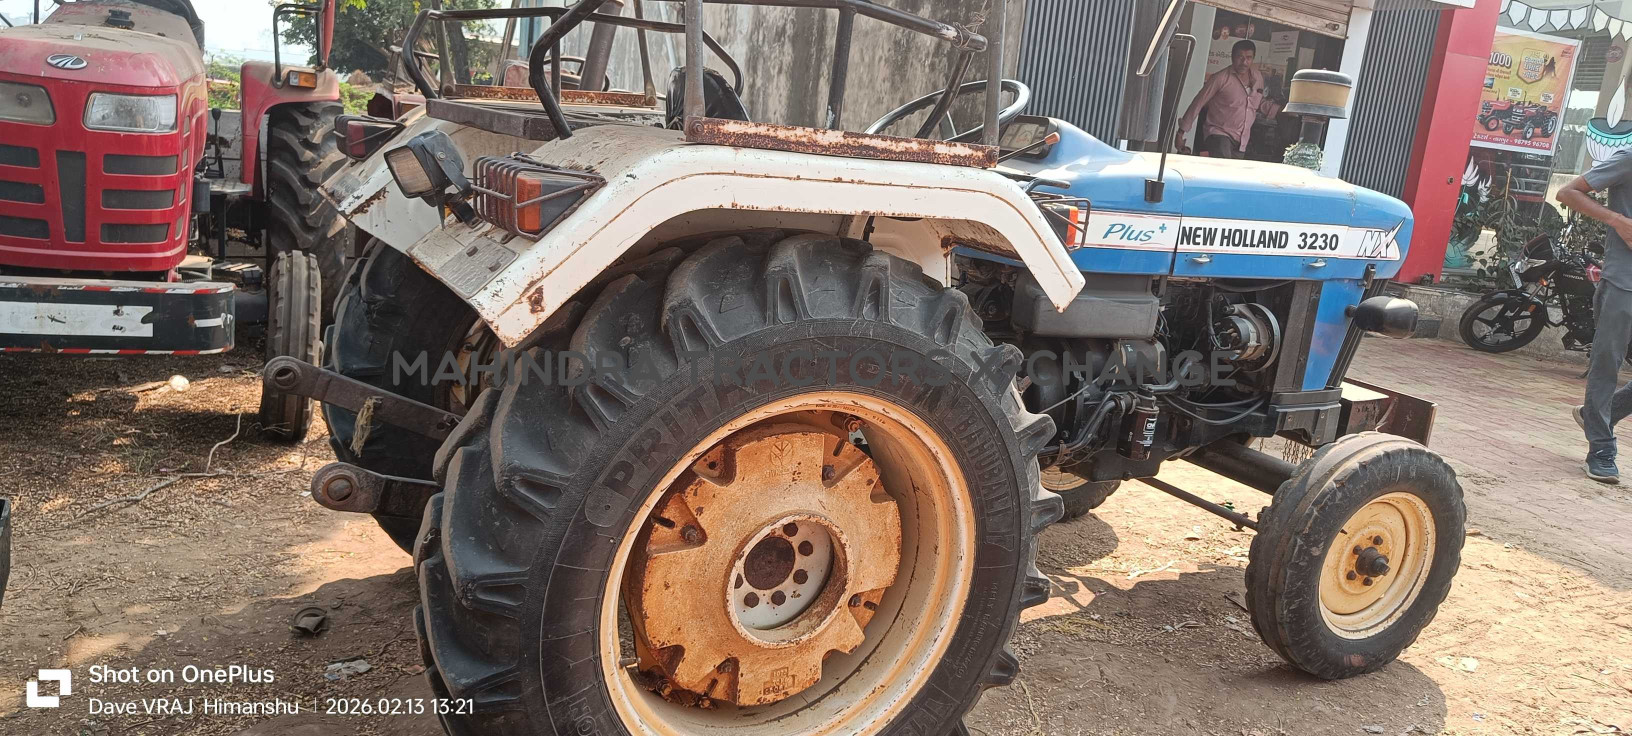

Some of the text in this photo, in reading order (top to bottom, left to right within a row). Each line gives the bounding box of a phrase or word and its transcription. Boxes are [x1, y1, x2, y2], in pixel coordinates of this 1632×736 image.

[1489, 52, 1512, 69] 1000
[1180, 226, 1339, 251] NEW HOLLAND 3230
[1357, 217, 1406, 258] NX
